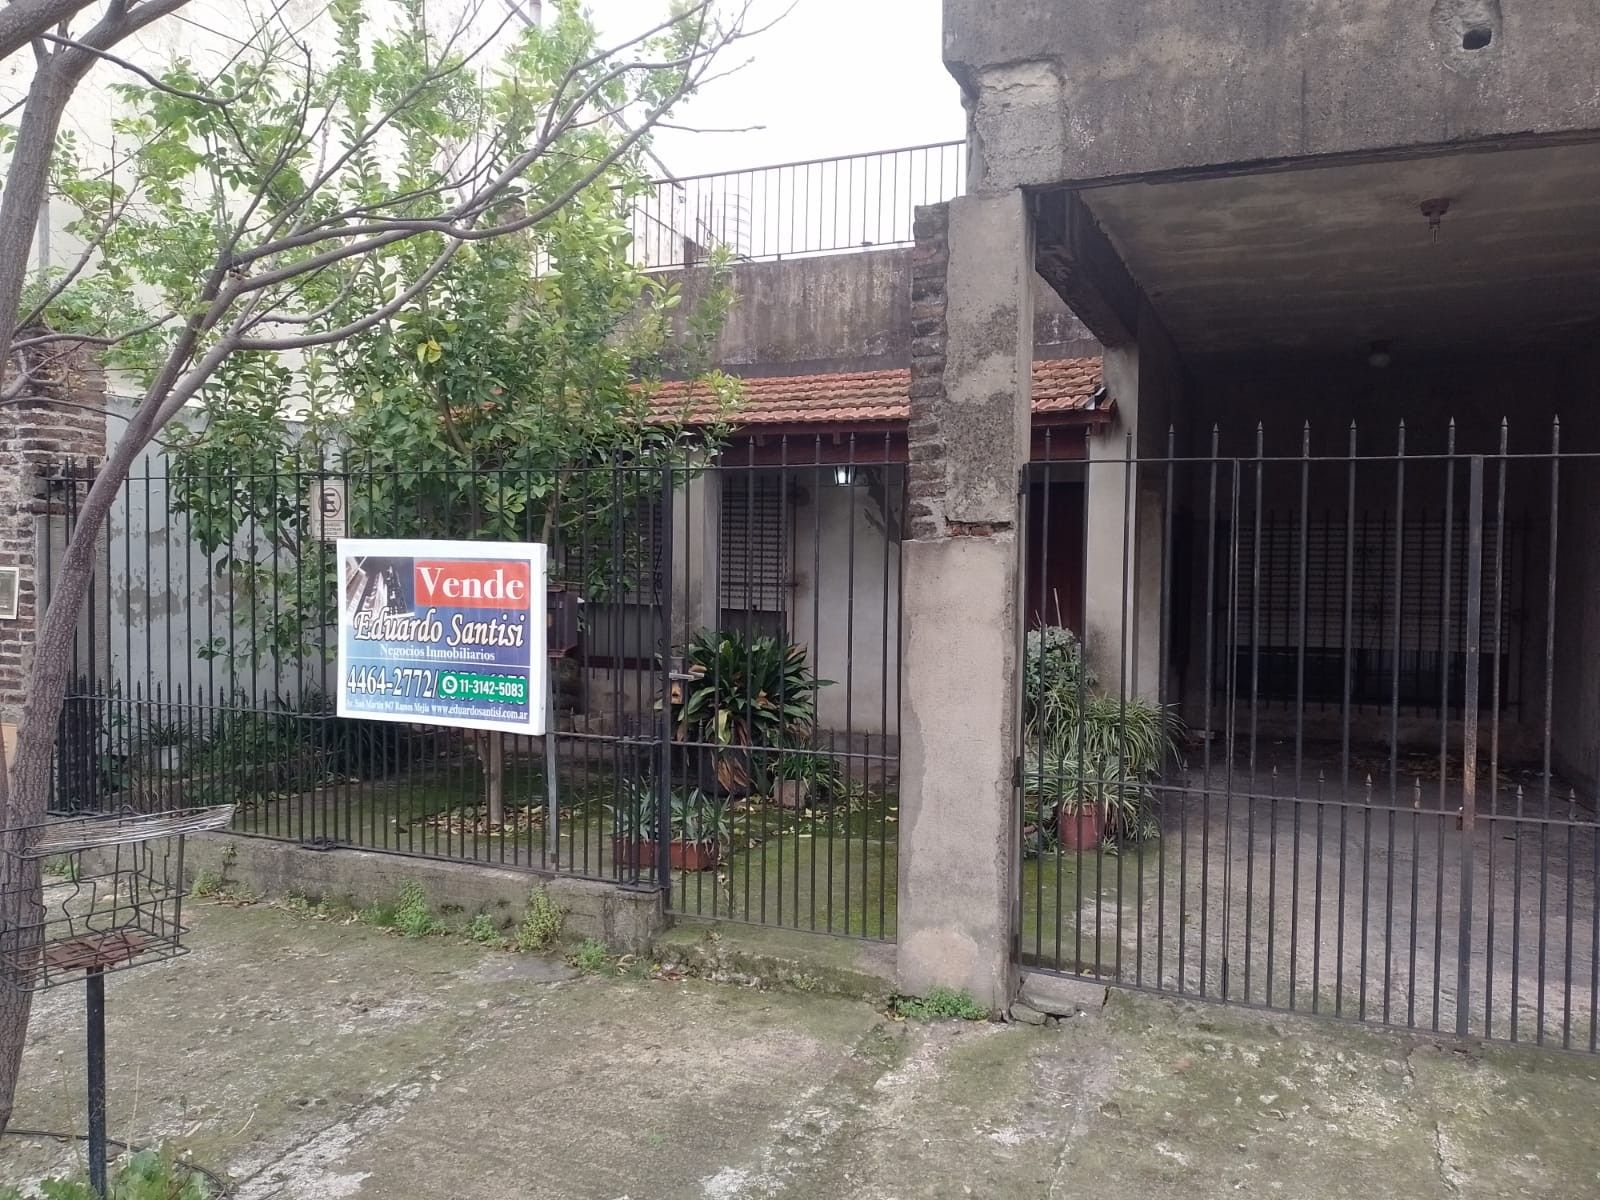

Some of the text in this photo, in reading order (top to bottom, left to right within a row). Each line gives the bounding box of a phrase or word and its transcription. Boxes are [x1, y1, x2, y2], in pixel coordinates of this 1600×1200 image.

[322, 493, 336, 512] E
[416, 566, 525, 600] Vende
[353, 606, 526, 647] Eduardo Santisi
[380, 643, 496, 661] Negocios Inmobiliarios
[459, 678, 524, 698] 11-3142-5083
[431, 704, 529, 720] www.eduardosantisi.com.ar
